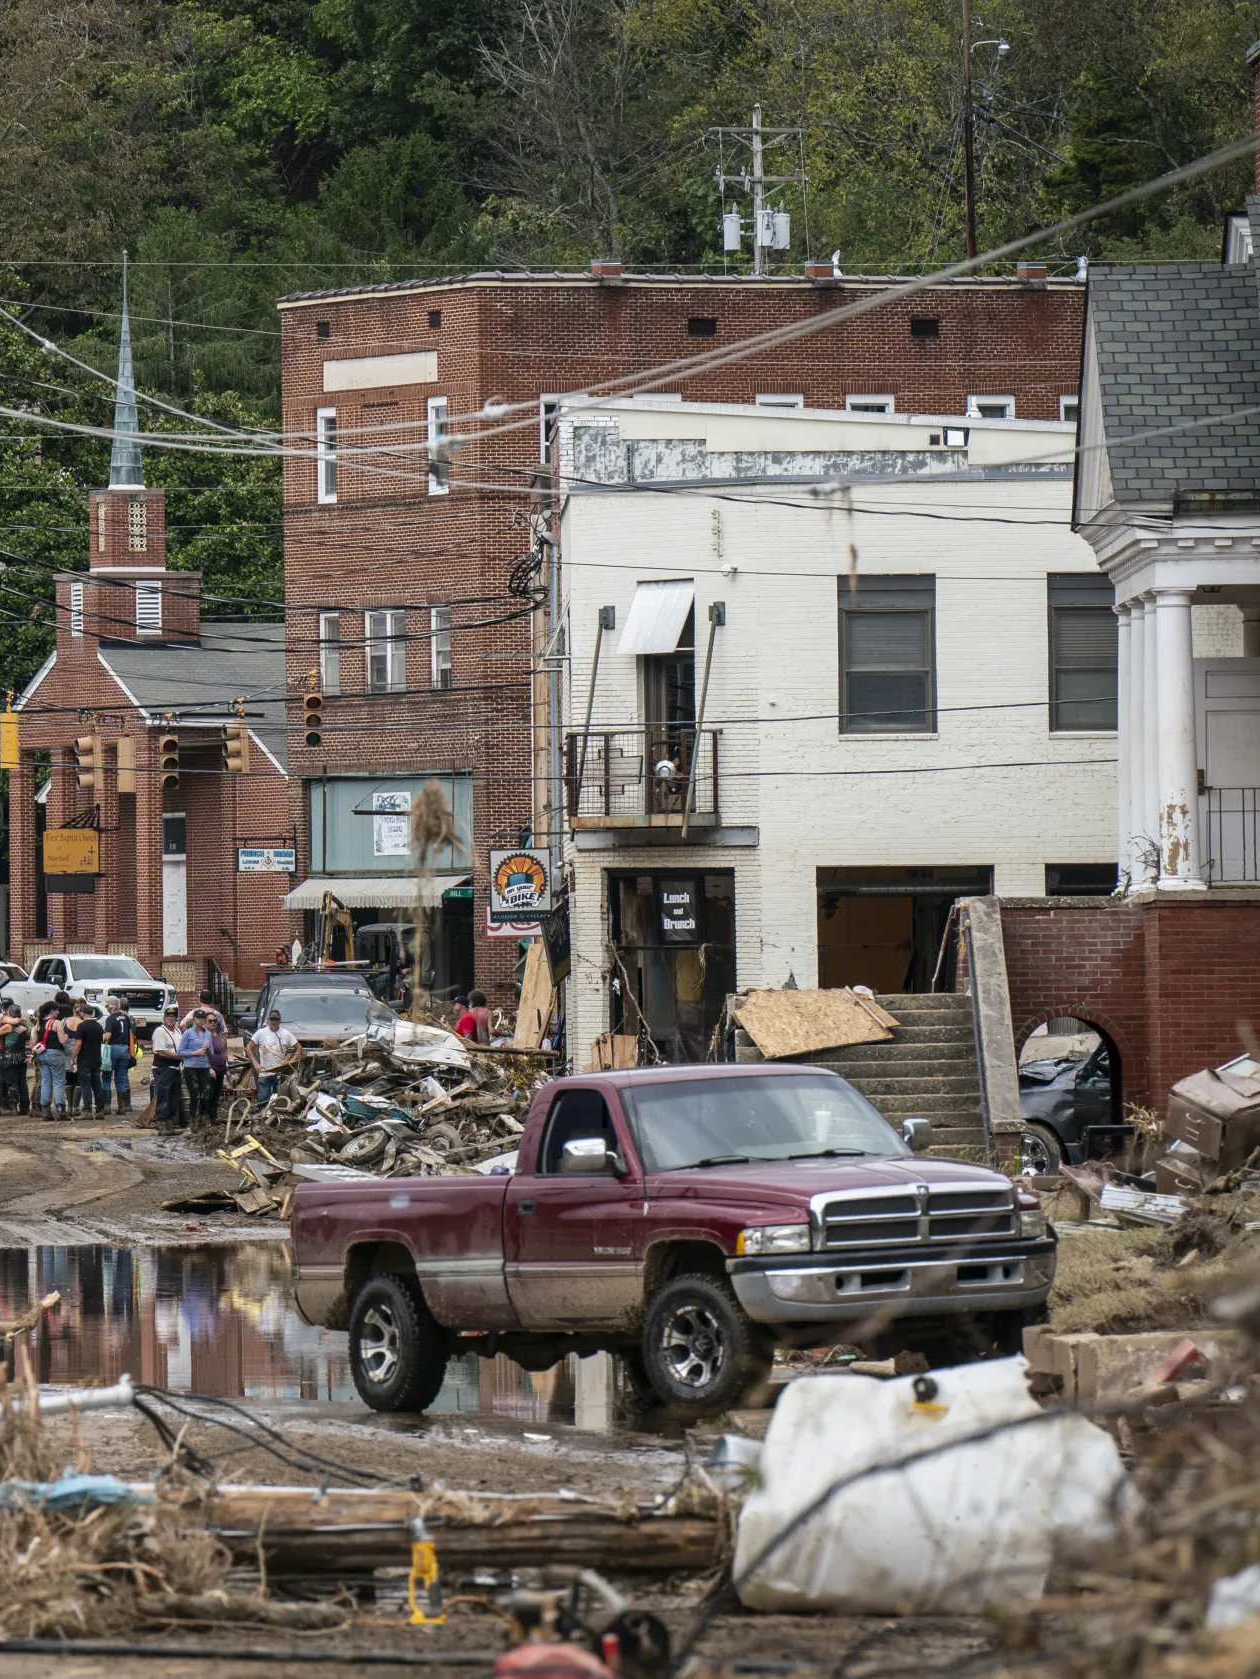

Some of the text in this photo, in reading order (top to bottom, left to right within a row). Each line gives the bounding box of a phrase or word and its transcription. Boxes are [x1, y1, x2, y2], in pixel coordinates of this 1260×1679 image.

[45, 833, 97, 844] First Baptist Church
[48, 854, 70, 862] Marshall
[240, 850, 294, 858] FRENCH BROAD
[507, 885, 533, 895] on your
[511, 892, 536, 904] BIKE
[663, 892, 690, 904] Lunch
[663, 918, 695, 930] Brunch
